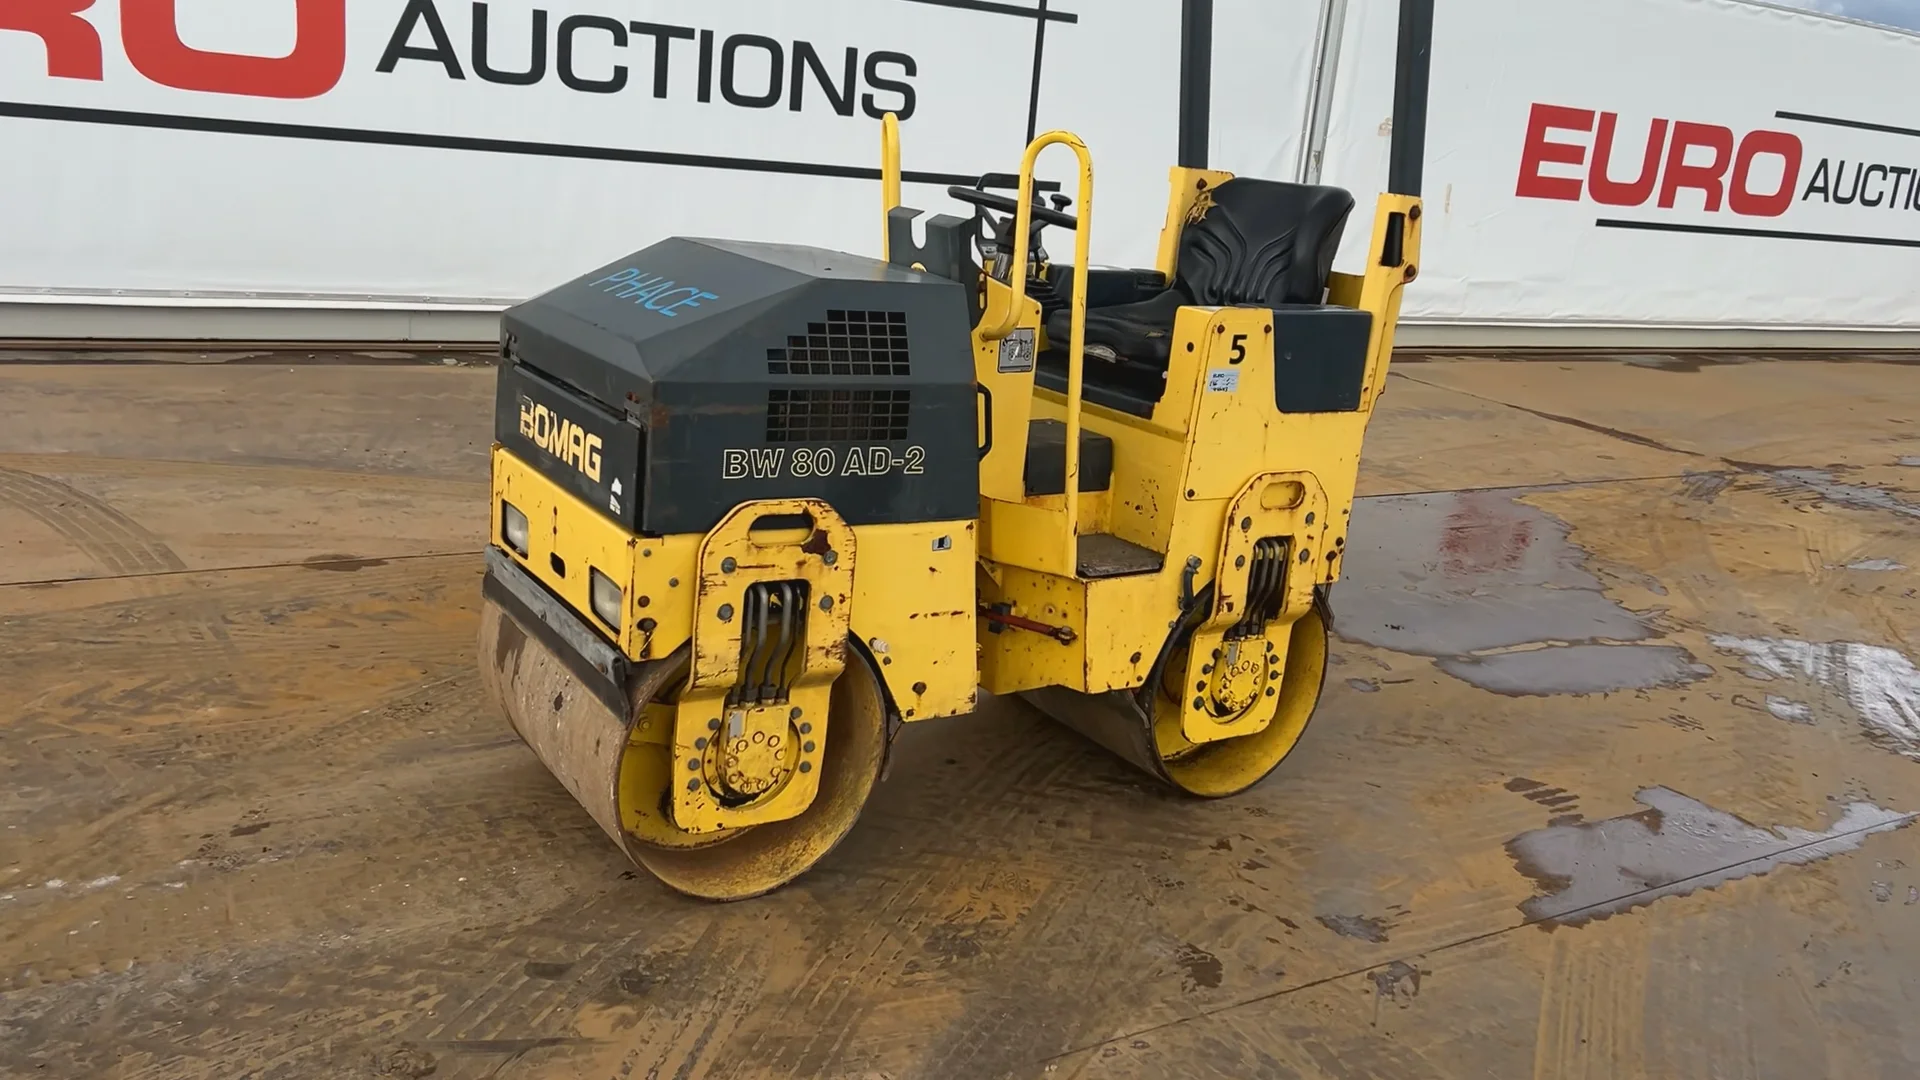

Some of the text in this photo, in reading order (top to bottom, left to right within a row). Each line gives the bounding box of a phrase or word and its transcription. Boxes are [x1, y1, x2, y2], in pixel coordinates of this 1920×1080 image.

[375, 0, 917, 121] AUCTIONS
[1515, 102, 1920, 217] EURO AUCTI
[1229, 334, 1248, 365] 5
[722, 445, 926, 479] BW 80 AD-2
